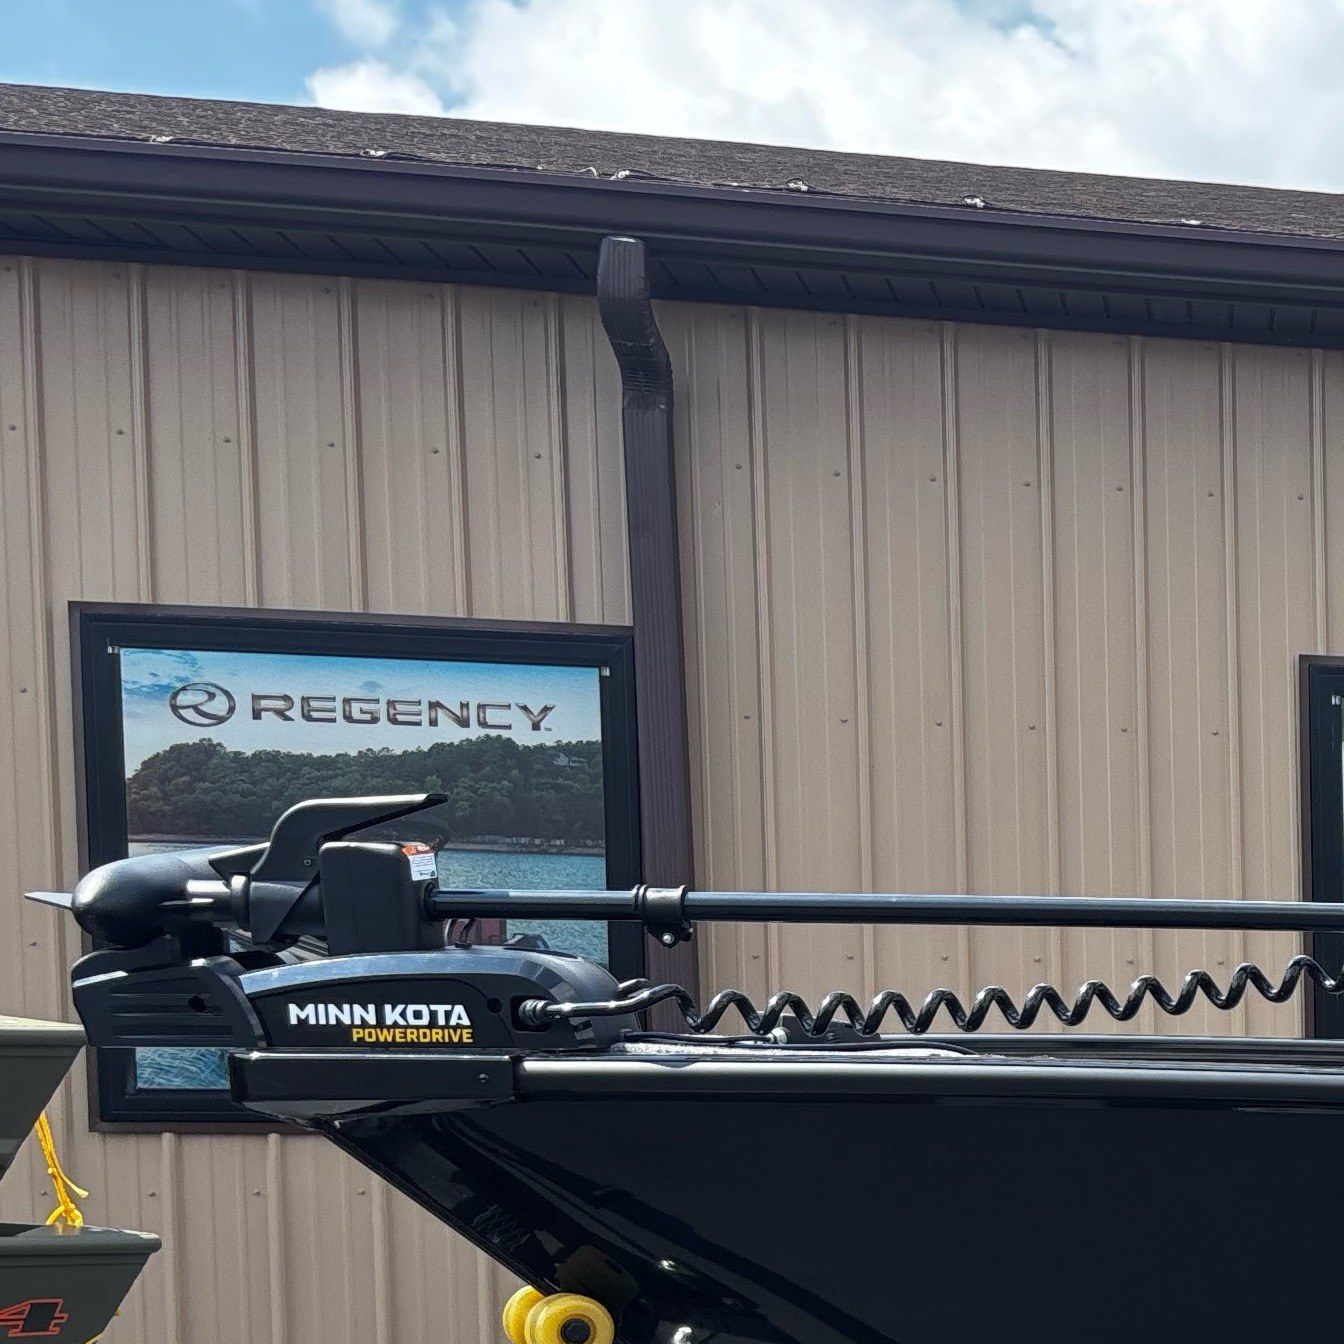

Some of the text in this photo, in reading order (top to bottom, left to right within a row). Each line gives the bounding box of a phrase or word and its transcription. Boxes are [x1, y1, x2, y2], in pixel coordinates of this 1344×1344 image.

[251, 692, 556, 731] REGENCY
[288, 1003, 471, 1026] MINN KOTA
[352, 1028, 474, 1044] POWERDRIVE
